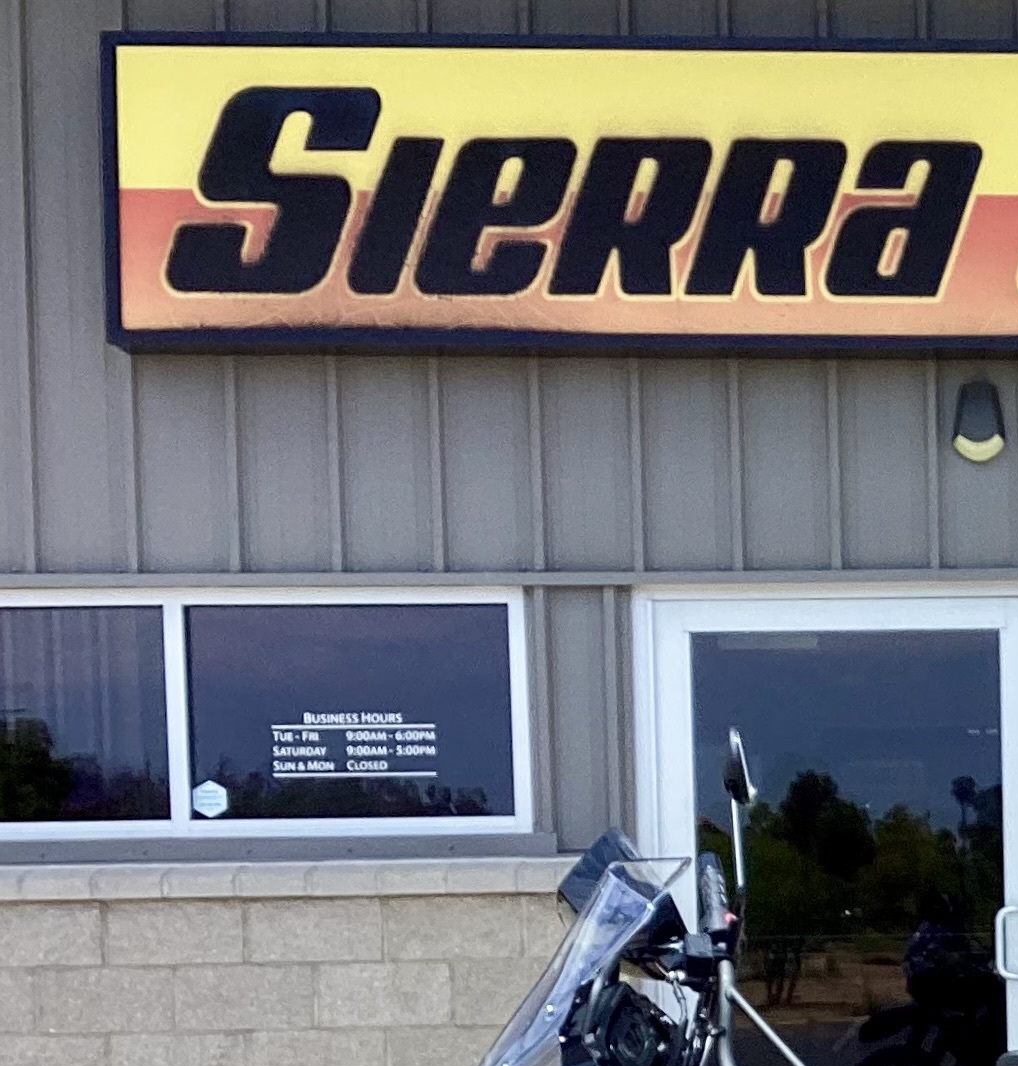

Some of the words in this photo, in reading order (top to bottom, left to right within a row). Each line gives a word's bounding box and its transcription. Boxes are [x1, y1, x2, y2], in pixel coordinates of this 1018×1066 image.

[303, 712, 359, 724] BUSINESS
[361, 711, 402, 723] HOURS
[273, 731, 293, 741] TUE
[302, 731, 319, 741] FRI
[345, 730, 387, 741] 9:00AM
[395, 730, 436, 740] 6:00PM
[273, 746, 326, 756] SATURDAY
[346, 745, 387, 756] 9:00AM
[273, 761, 296, 771] SUN
[307, 761, 335, 770] MON
[346, 760, 388, 770] CLOSED
